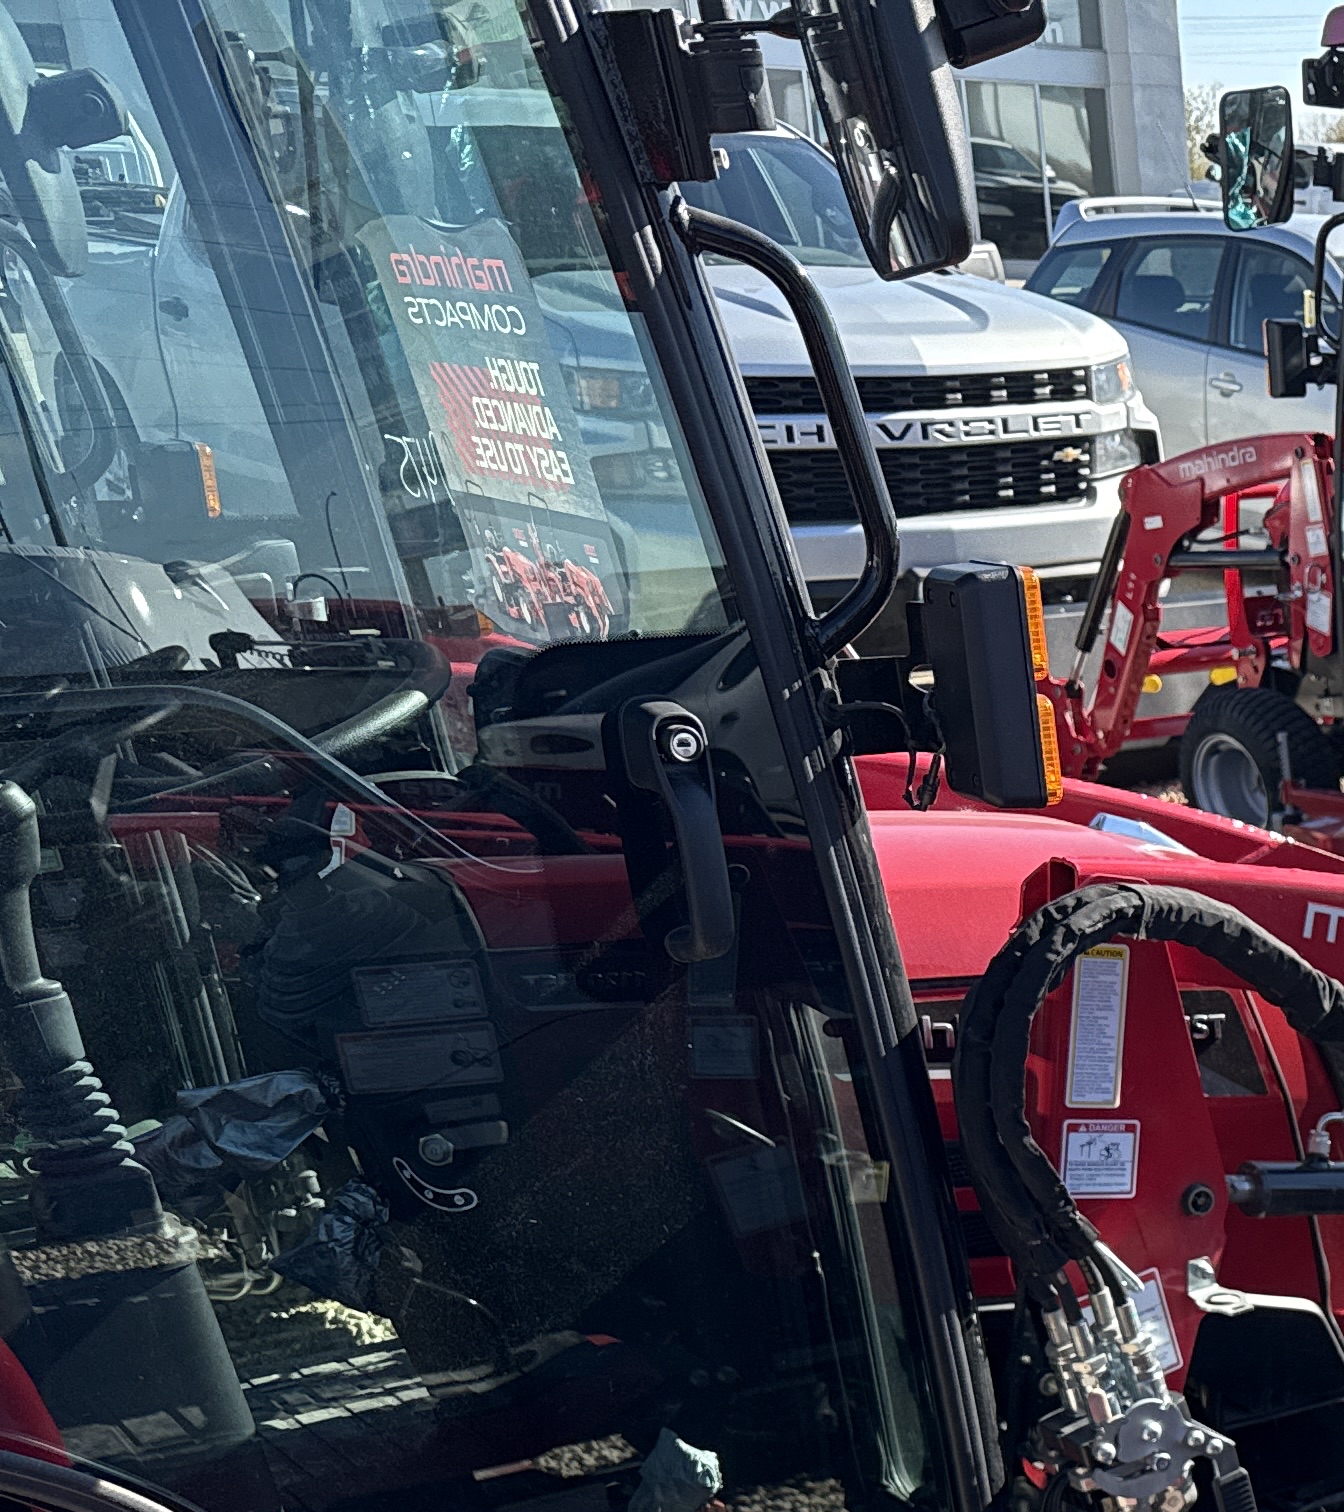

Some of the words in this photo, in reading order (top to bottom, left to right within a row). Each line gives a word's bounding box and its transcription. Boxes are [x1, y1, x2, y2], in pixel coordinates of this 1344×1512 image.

[758, 411, 1092, 445] CHVROLET
[1178, 445, 1257, 479] mahindra
[1090, 949, 1124, 958] CAUTION
[1184, 1013, 1226, 1039] ST
[1088, 1124, 1126, 1132] DANGER
